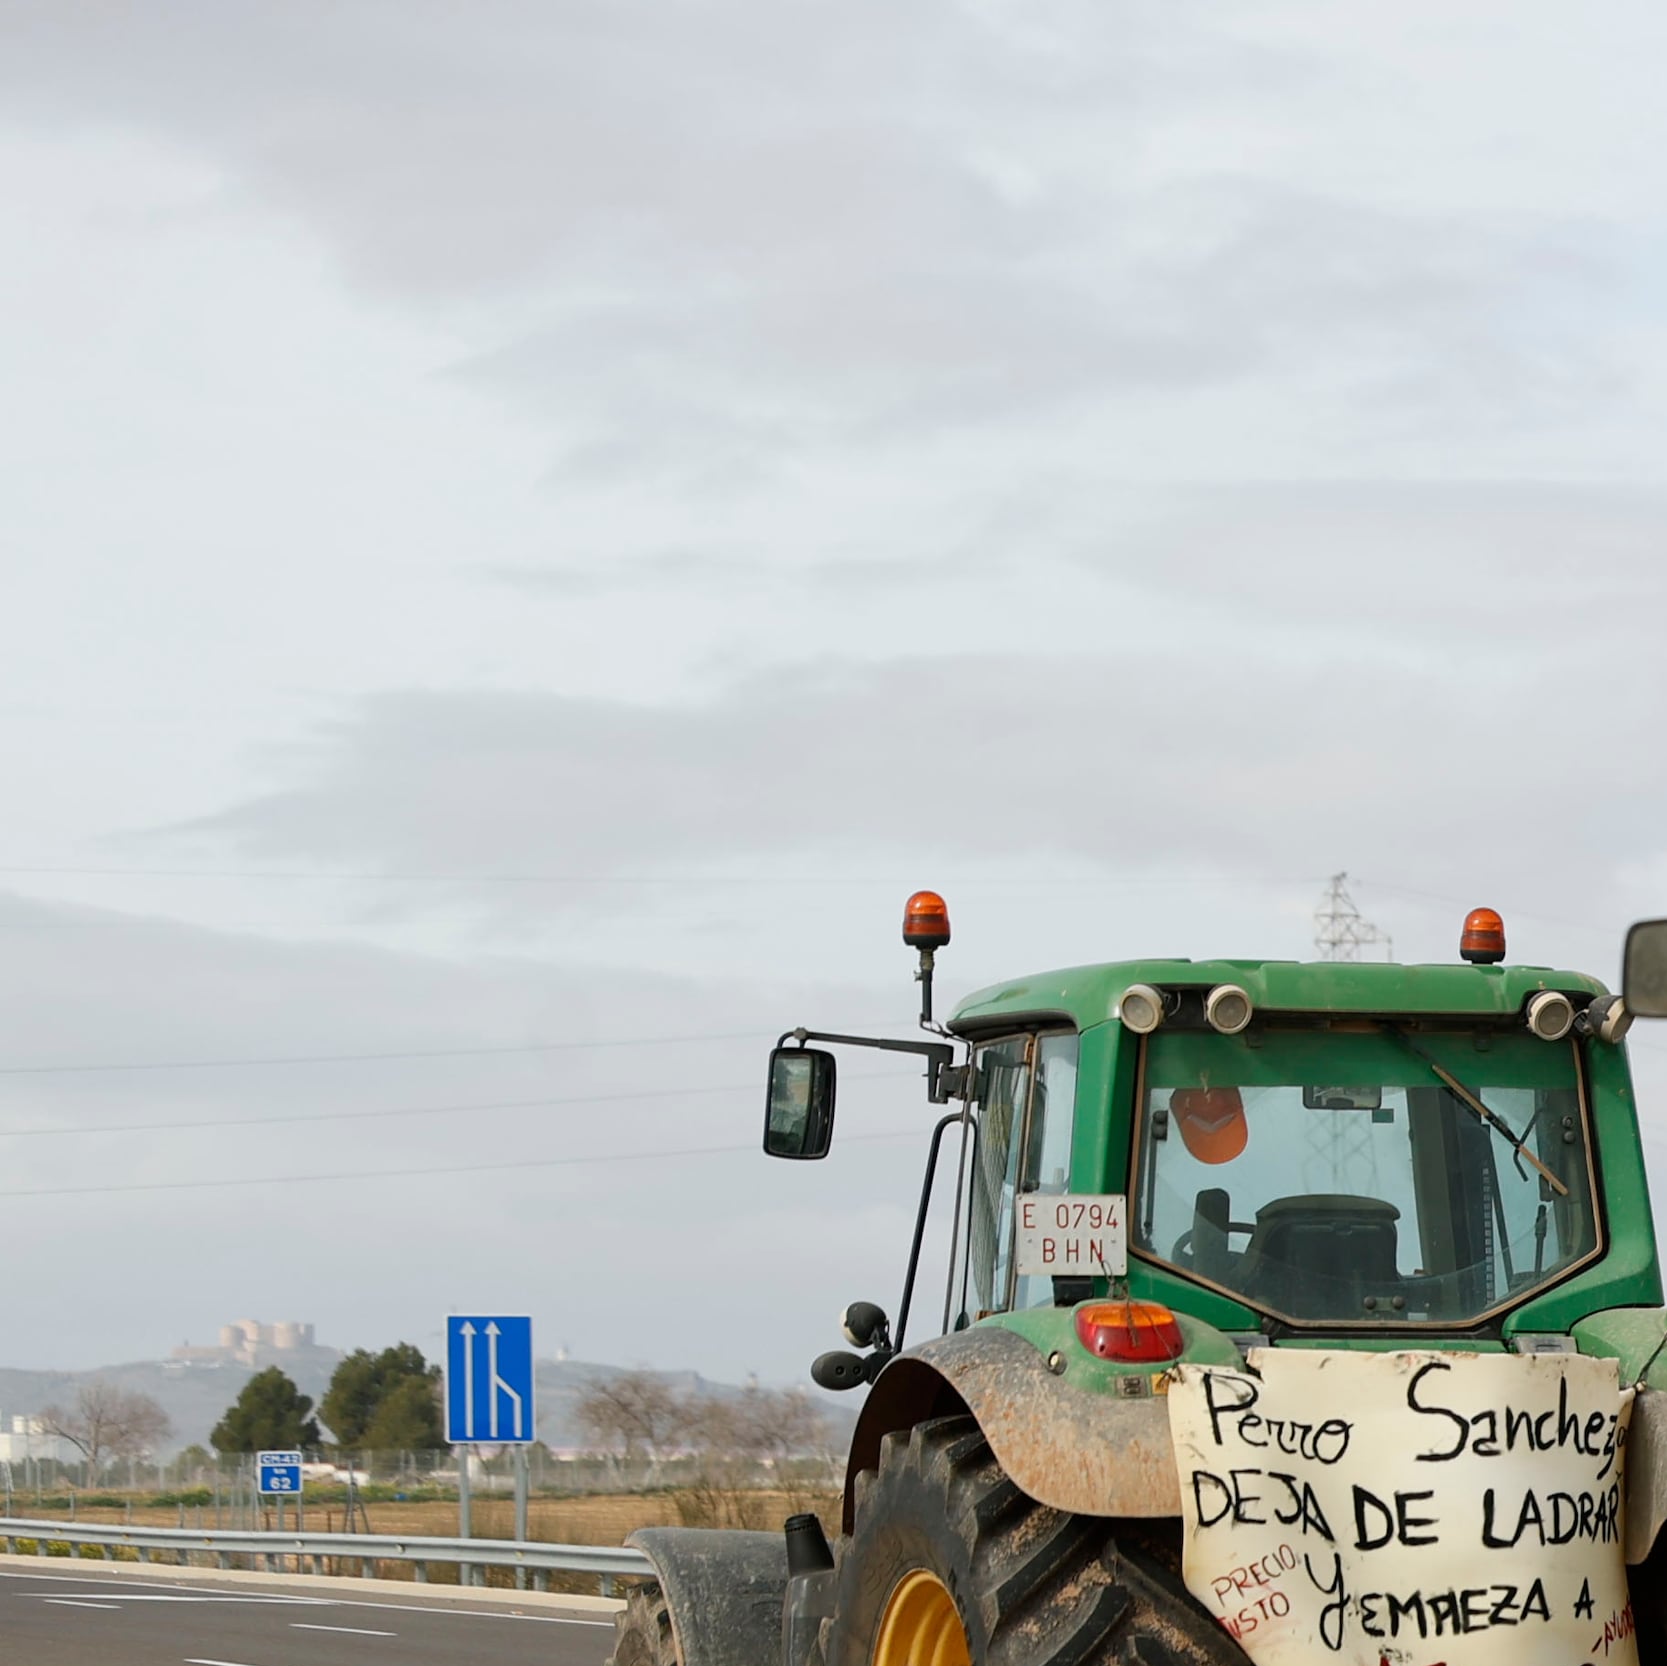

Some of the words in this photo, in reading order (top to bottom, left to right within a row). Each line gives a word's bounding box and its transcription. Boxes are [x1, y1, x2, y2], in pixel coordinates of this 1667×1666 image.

[1023, 1203, 1036, 1229] E
[1056, 1203, 1119, 1230] 0794
[1042, 1238, 1103, 1264] BHN
[1202, 1373, 1353, 1464] Perro
[270, 1476, 292, 1490] 62
[1192, 1469, 1336, 1542] DEJA
[1352, 1485, 1439, 1551] DE
[1482, 1482, 1619, 1548] LADRAR
[1211, 1544, 1296, 1607] PRECIO
[1574, 1577, 1595, 1621] A
